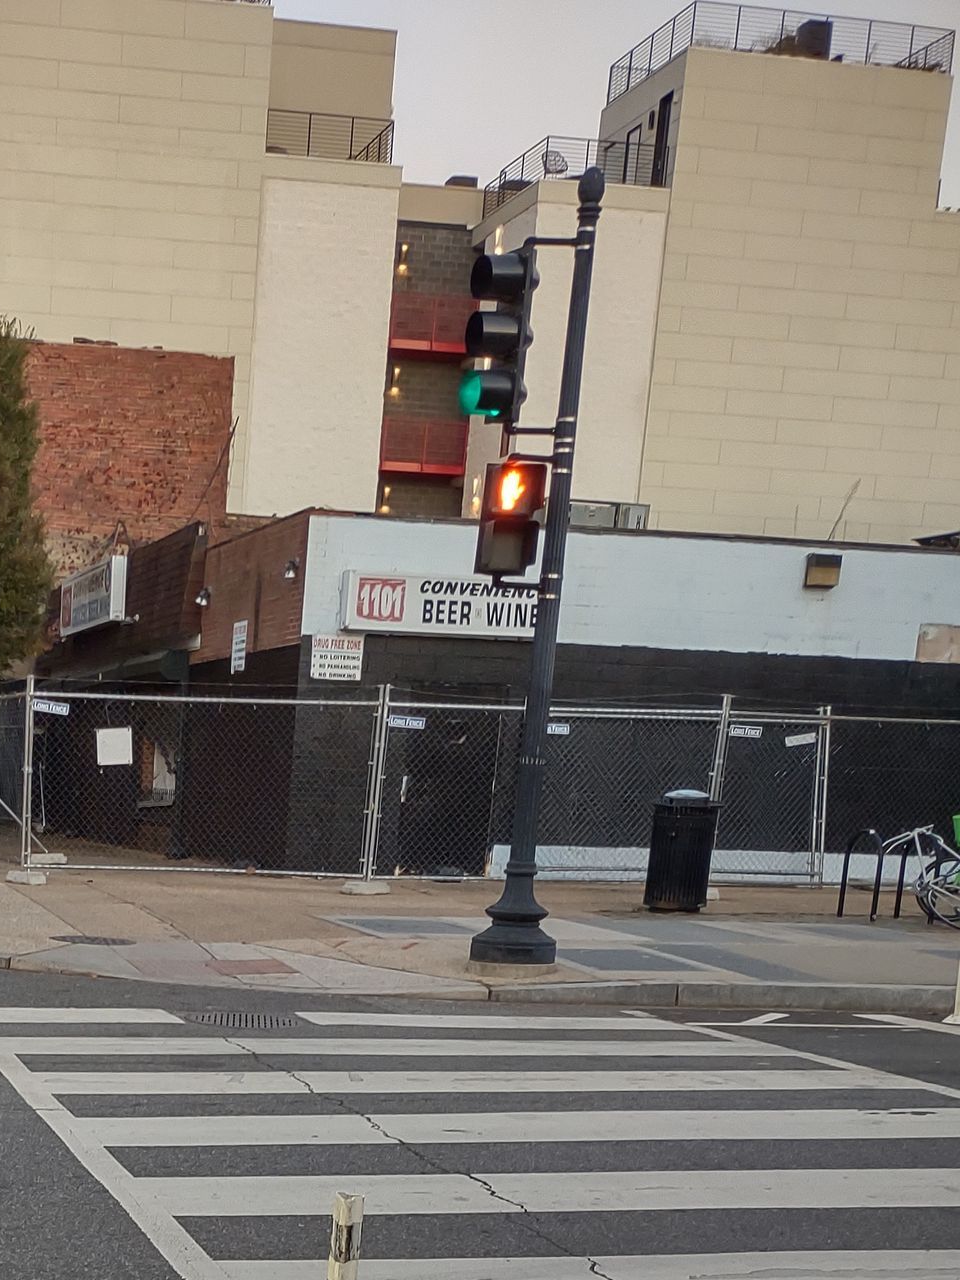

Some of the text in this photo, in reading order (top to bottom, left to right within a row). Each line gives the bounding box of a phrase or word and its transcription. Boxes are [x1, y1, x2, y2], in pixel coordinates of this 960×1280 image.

[359, 582, 404, 619] 1101
[422, 599, 472, 626] BEER
[314, 638, 362, 651] DRUG FREE ZONE
[49, 703, 67, 713] FENCE
